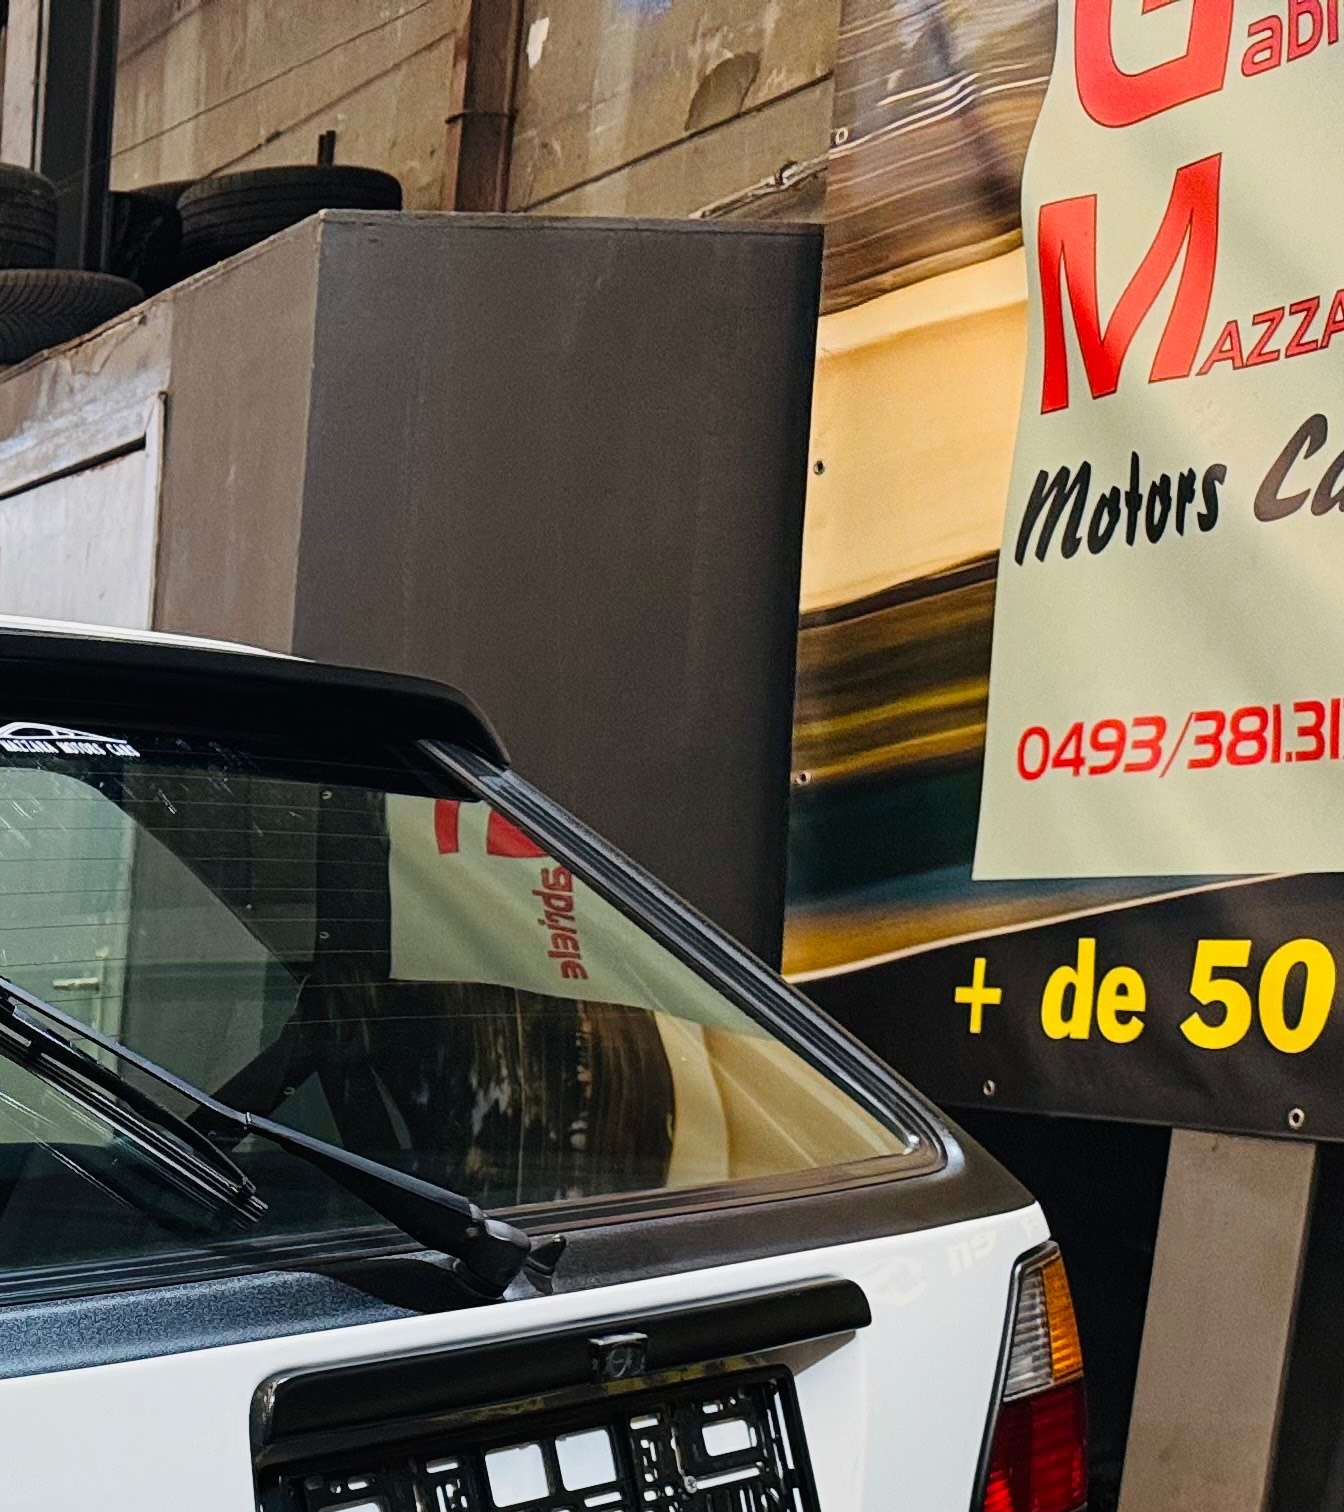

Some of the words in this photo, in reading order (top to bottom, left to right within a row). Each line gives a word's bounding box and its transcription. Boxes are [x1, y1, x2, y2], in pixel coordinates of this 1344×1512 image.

[1015, 451, 1227, 566] Motors
[1017, 698, 1344, 781] 0493/381.31
[1041, 938, 1147, 1044] de
[1180, 938, 1336, 1054] 50
